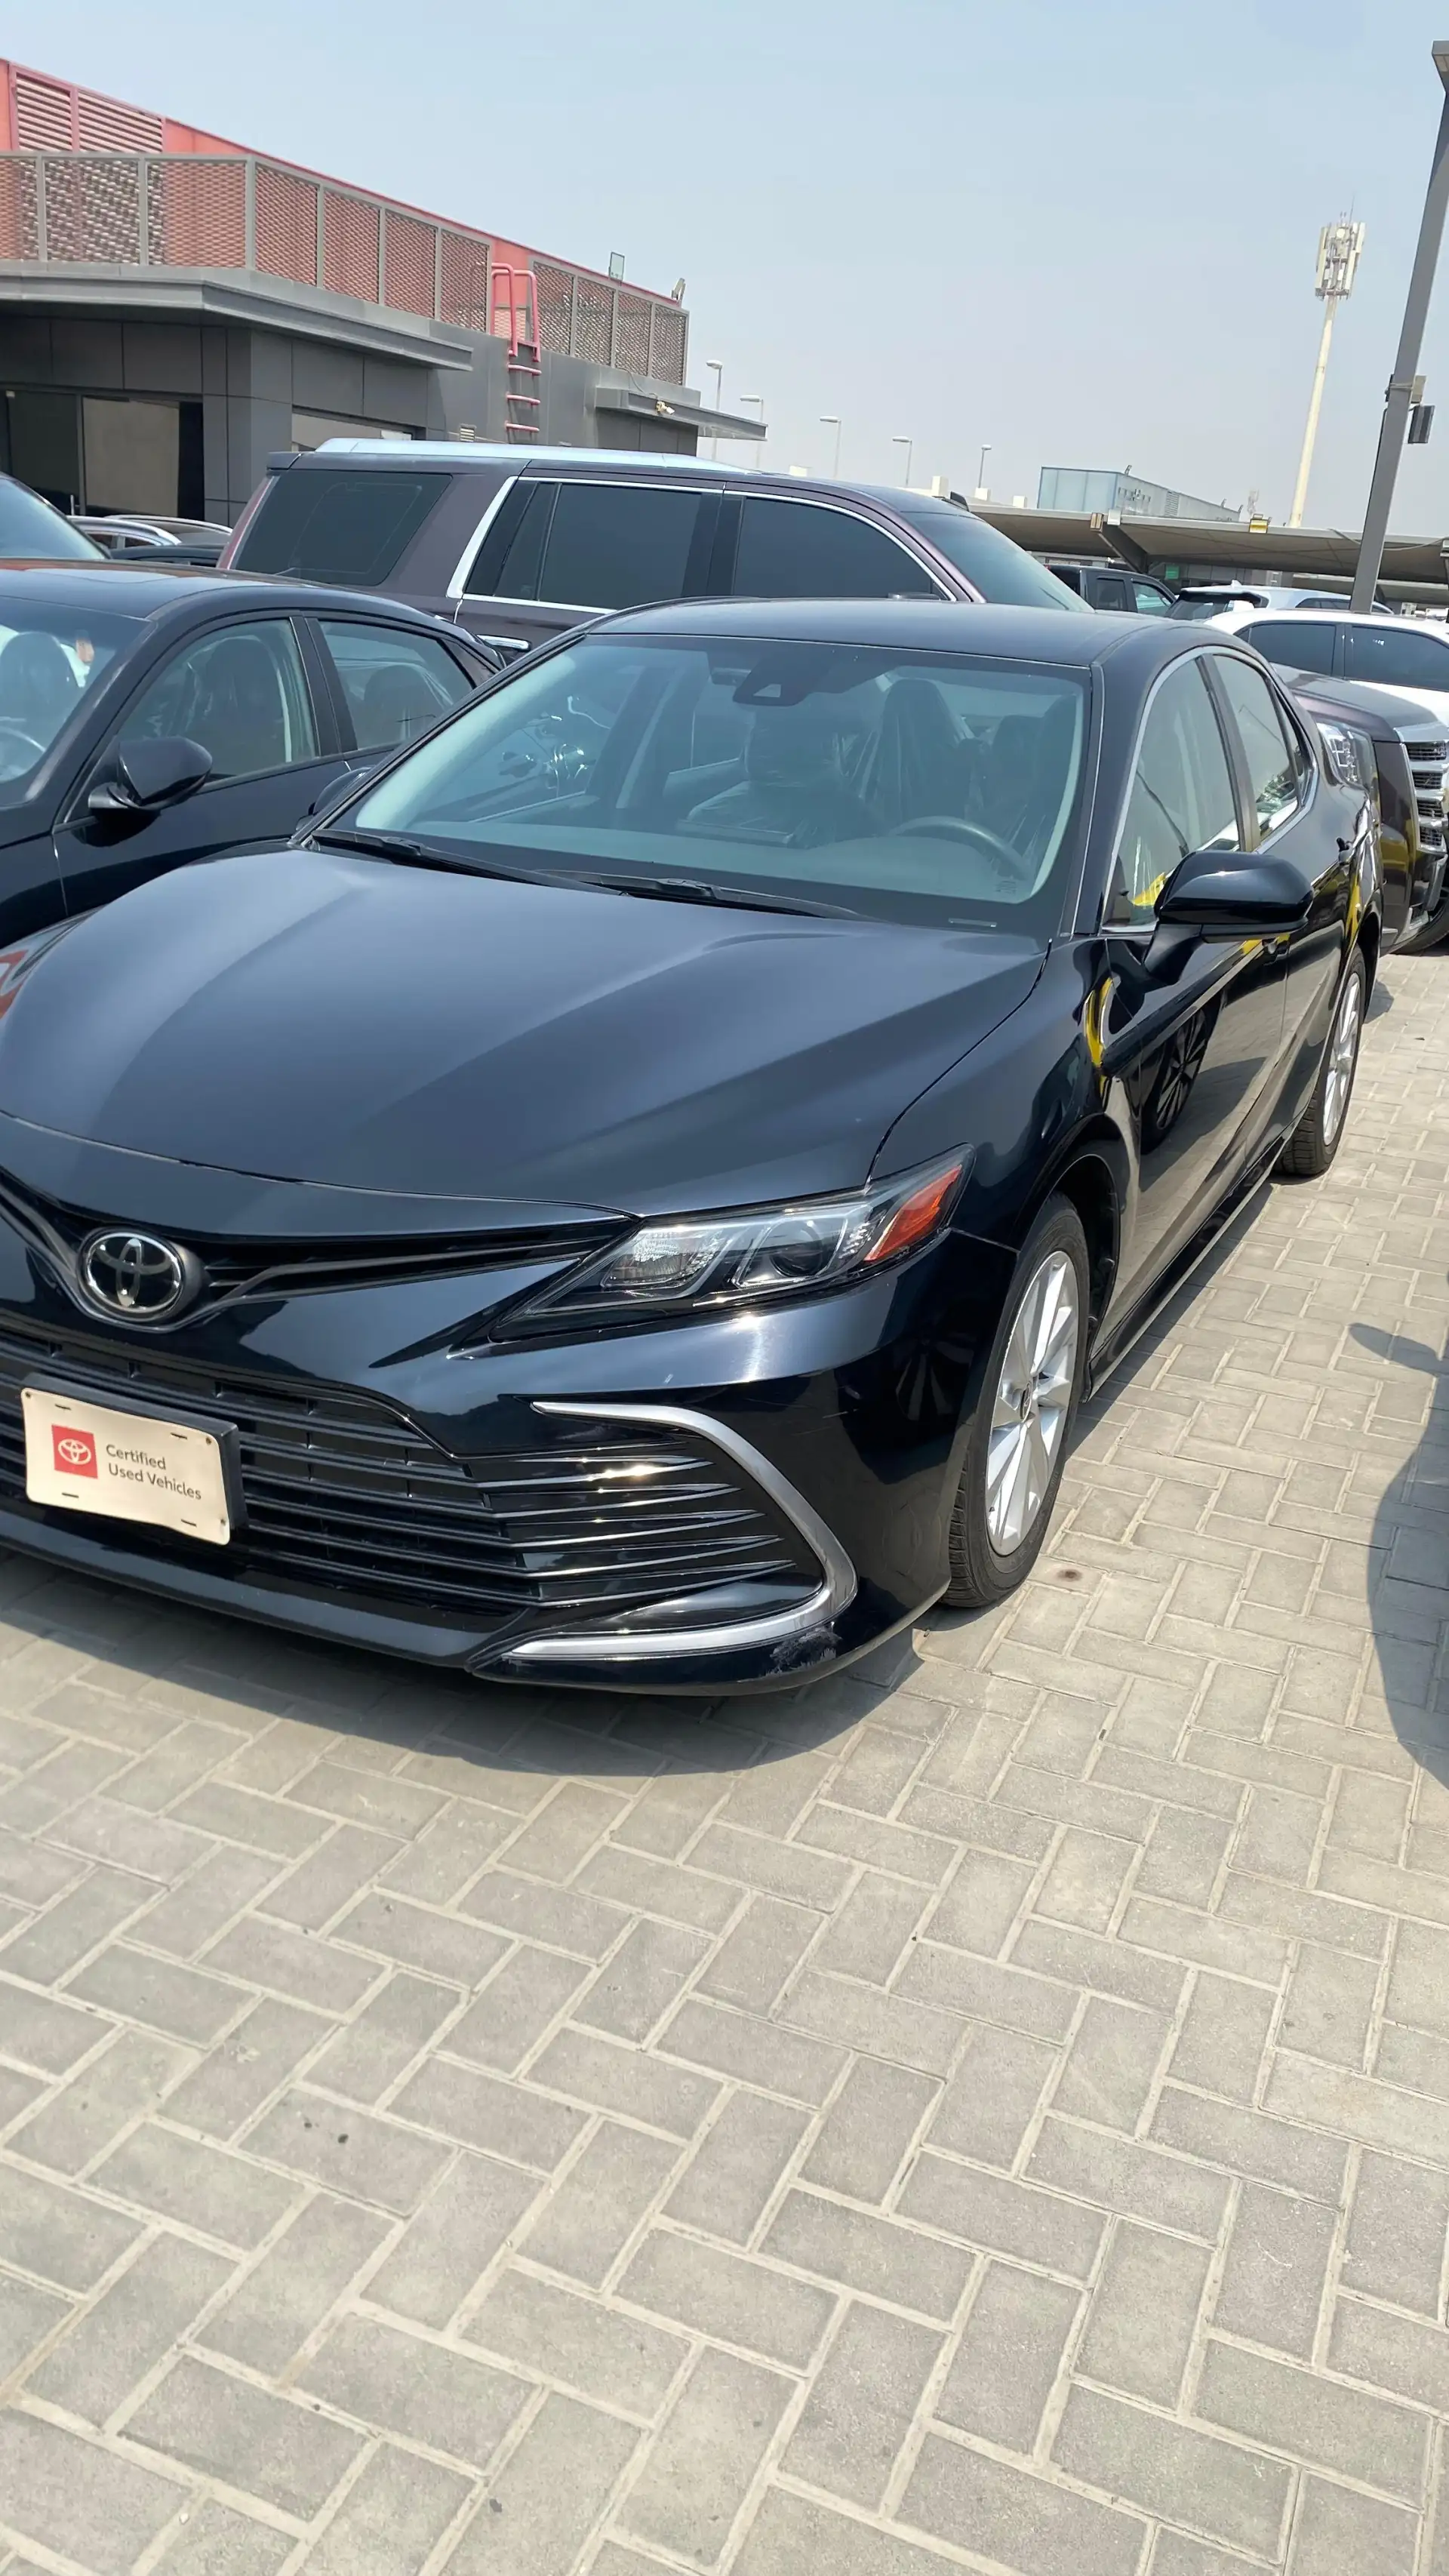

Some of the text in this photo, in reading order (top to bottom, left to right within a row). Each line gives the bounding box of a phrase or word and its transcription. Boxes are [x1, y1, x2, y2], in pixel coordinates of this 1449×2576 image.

[106, 1444, 166, 1470] Certified
[108, 1463, 202, 1500] Used Vehicles
